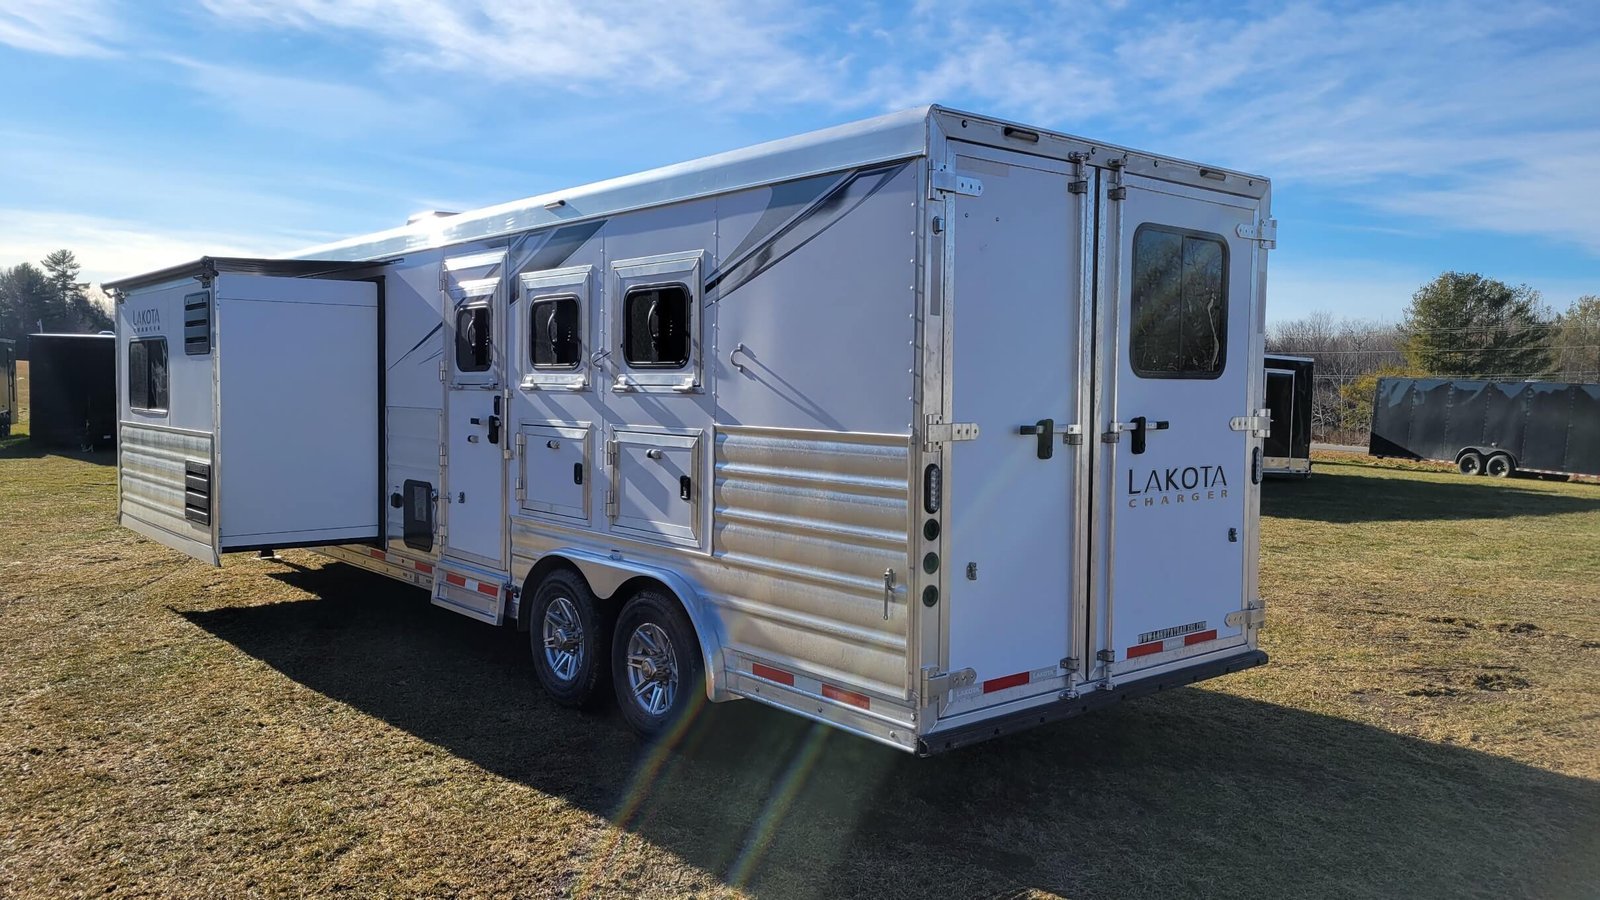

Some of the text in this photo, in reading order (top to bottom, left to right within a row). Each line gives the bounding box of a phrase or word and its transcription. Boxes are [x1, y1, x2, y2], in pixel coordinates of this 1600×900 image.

[133, 309, 160, 325] LAKOTA
[1128, 465, 1228, 495] LAKOTA
[1128, 489, 1229, 508] CHARGER
